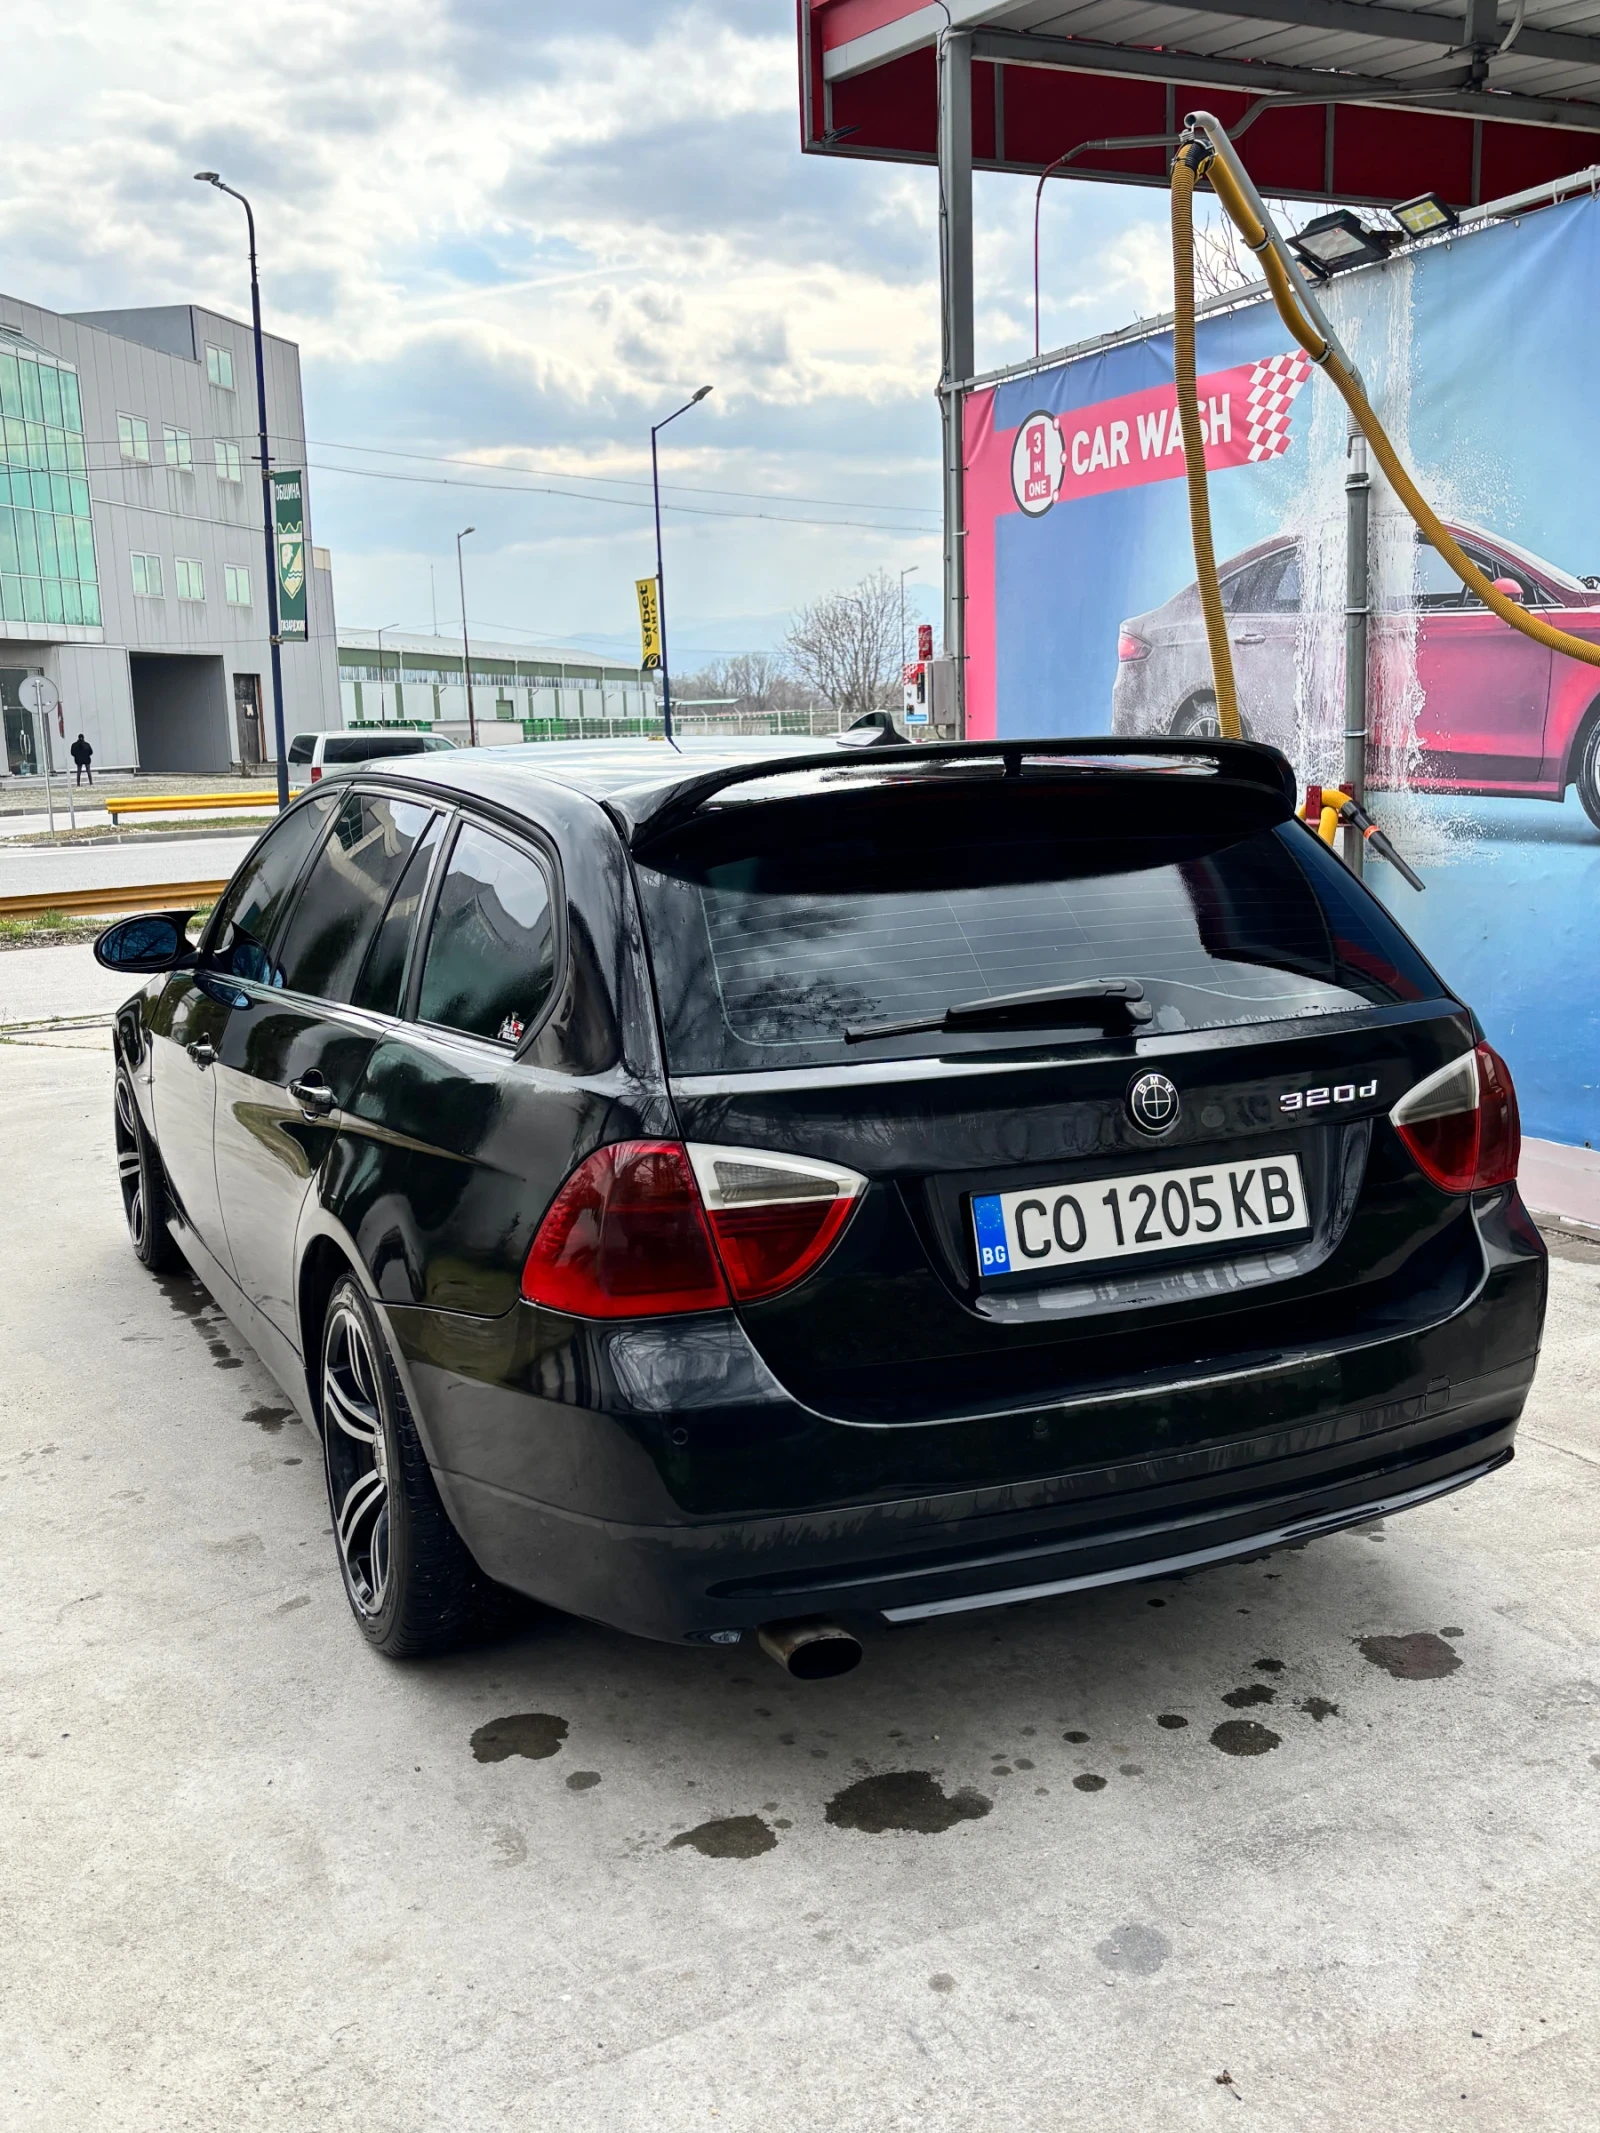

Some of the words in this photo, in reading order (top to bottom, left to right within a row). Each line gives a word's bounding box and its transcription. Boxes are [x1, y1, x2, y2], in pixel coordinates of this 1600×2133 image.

[1033, 432, 1042, 453] 3
[1071, 421, 1130, 476] CAR
[1033, 461, 1042, 473] IN
[275, 482, 301, 500] ОБЩИНА
[1029, 480, 1047, 497] ONE
[640, 584, 652, 648] efbet
[1136, 1073, 1174, 1094] BMW
[1279, 1079, 1379, 1113] 320d
[1014, 1194, 1087, 1259] CO
[1101, 1174, 1223, 1247] 1205
[1228, 1165, 1296, 1229] KB
[982, 1244, 1007, 1267] BG
